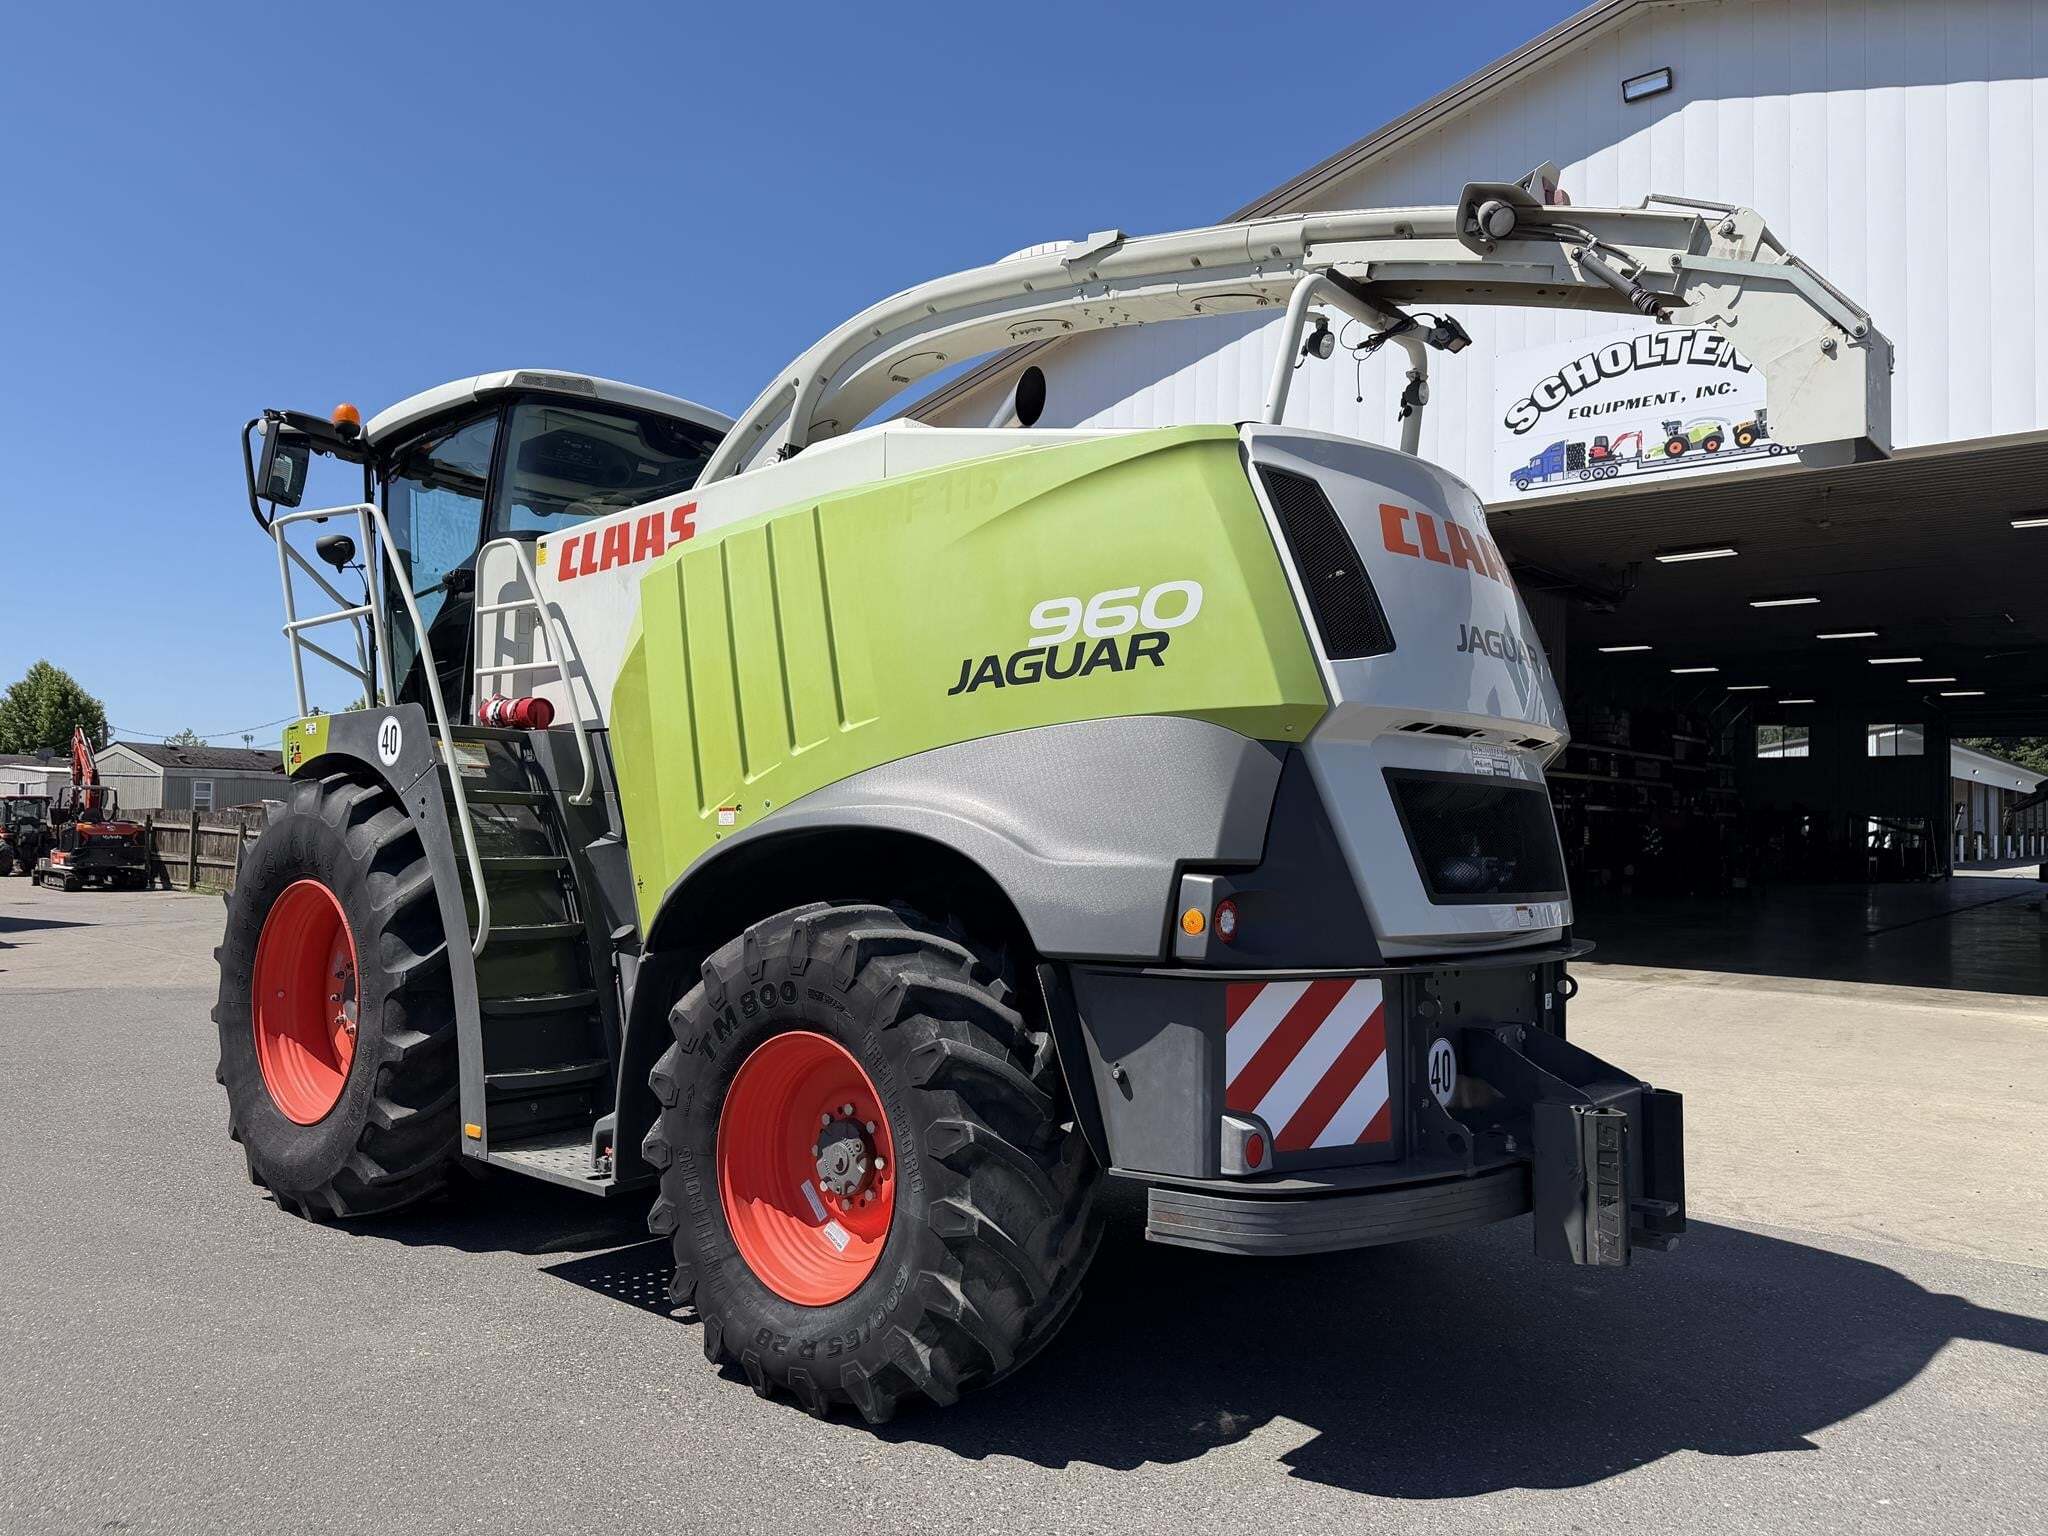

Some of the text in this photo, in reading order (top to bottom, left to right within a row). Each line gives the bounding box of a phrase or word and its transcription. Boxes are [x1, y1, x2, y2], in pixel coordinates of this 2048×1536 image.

[1568, 382, 1738, 420] EQUIPMENT, INC.
[557, 501, 698, 582] CLAAS
[1027, 579, 1203, 648] 960
[947, 630, 1170, 696] JAGUAR
[1457, 623, 1540, 673] JAGUAR
[382, 724, 398, 755] 40
[698, 1005, 738, 1062] TM
[740, 980, 799, 1019] 800
[1431, 1049, 1451, 1094] 40
[755, 1327, 791, 1357] 28
